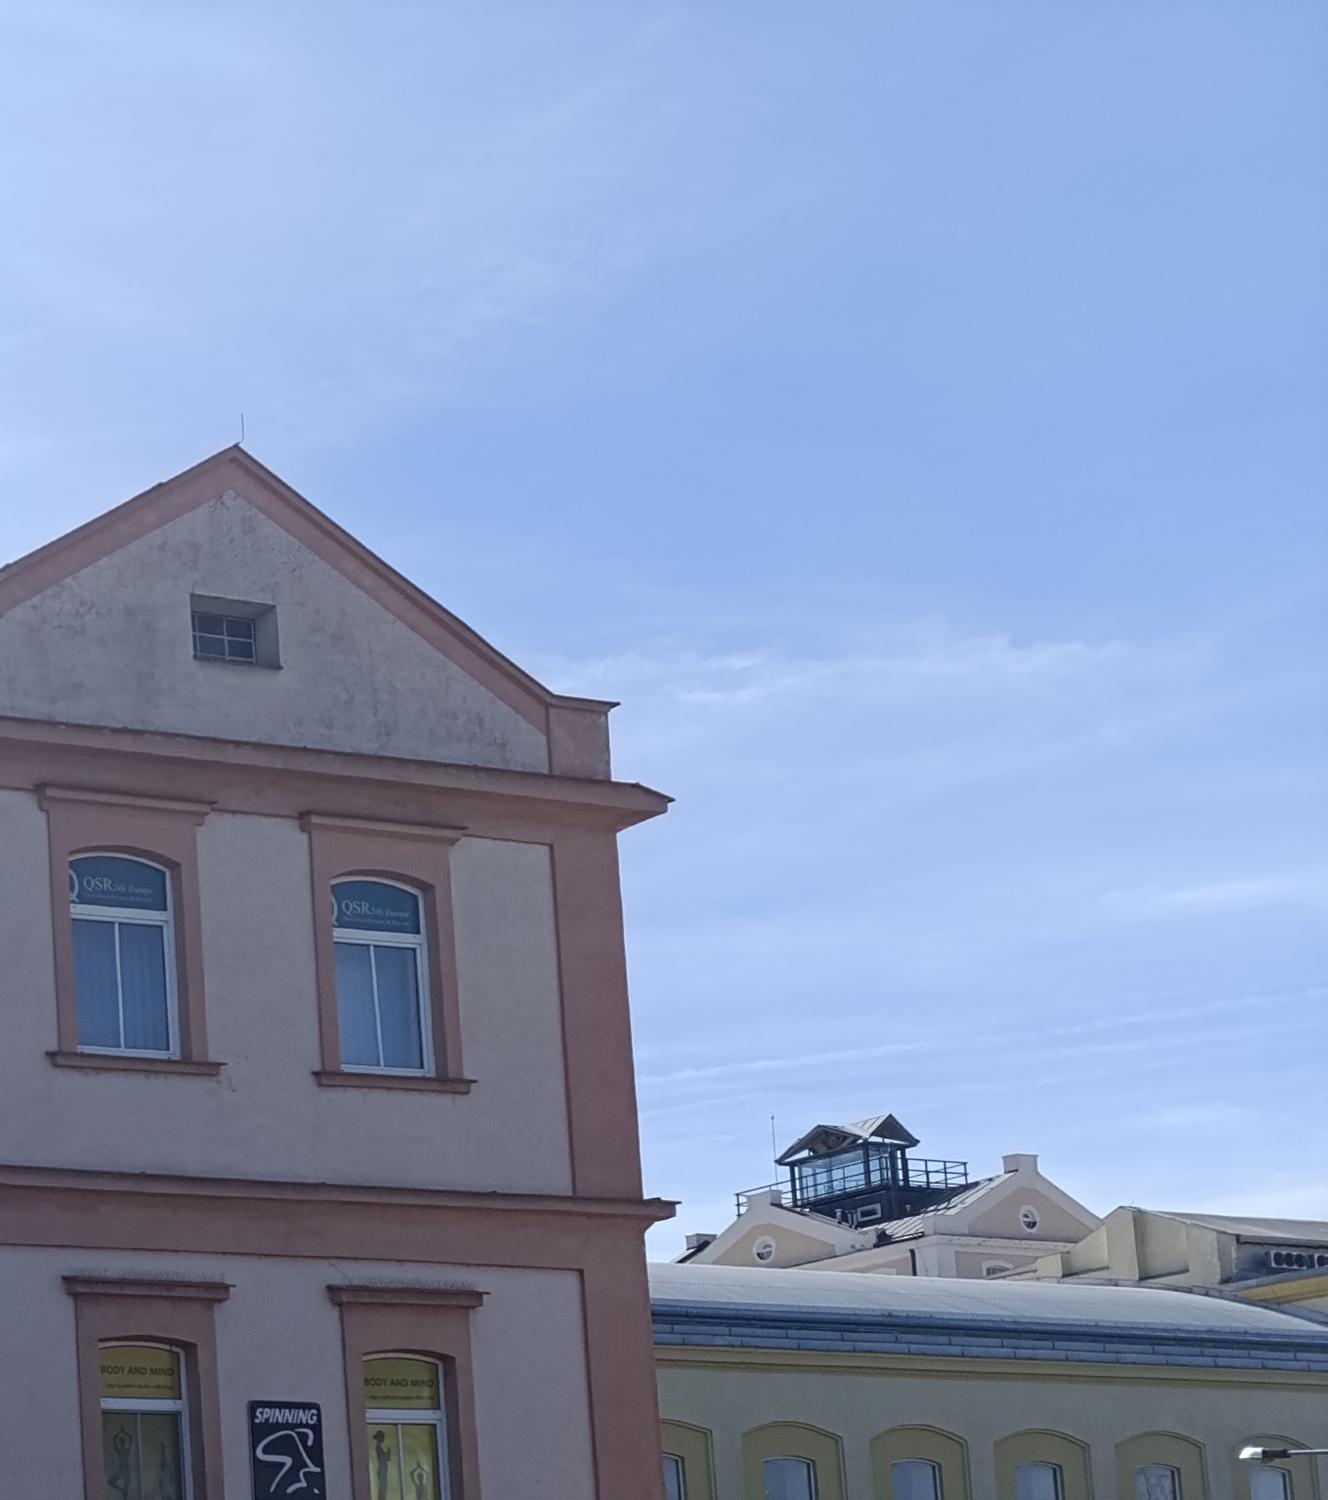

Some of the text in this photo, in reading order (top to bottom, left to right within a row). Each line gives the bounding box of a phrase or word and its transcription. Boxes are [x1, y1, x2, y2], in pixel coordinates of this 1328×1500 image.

[83, 876, 113, 893] QSR
[342, 900, 370, 916] QSR
[127, 1366, 148, 1376] AND
[389, 1378, 409, 1388] AND
[253, 1408, 319, 1426] SPINNING
